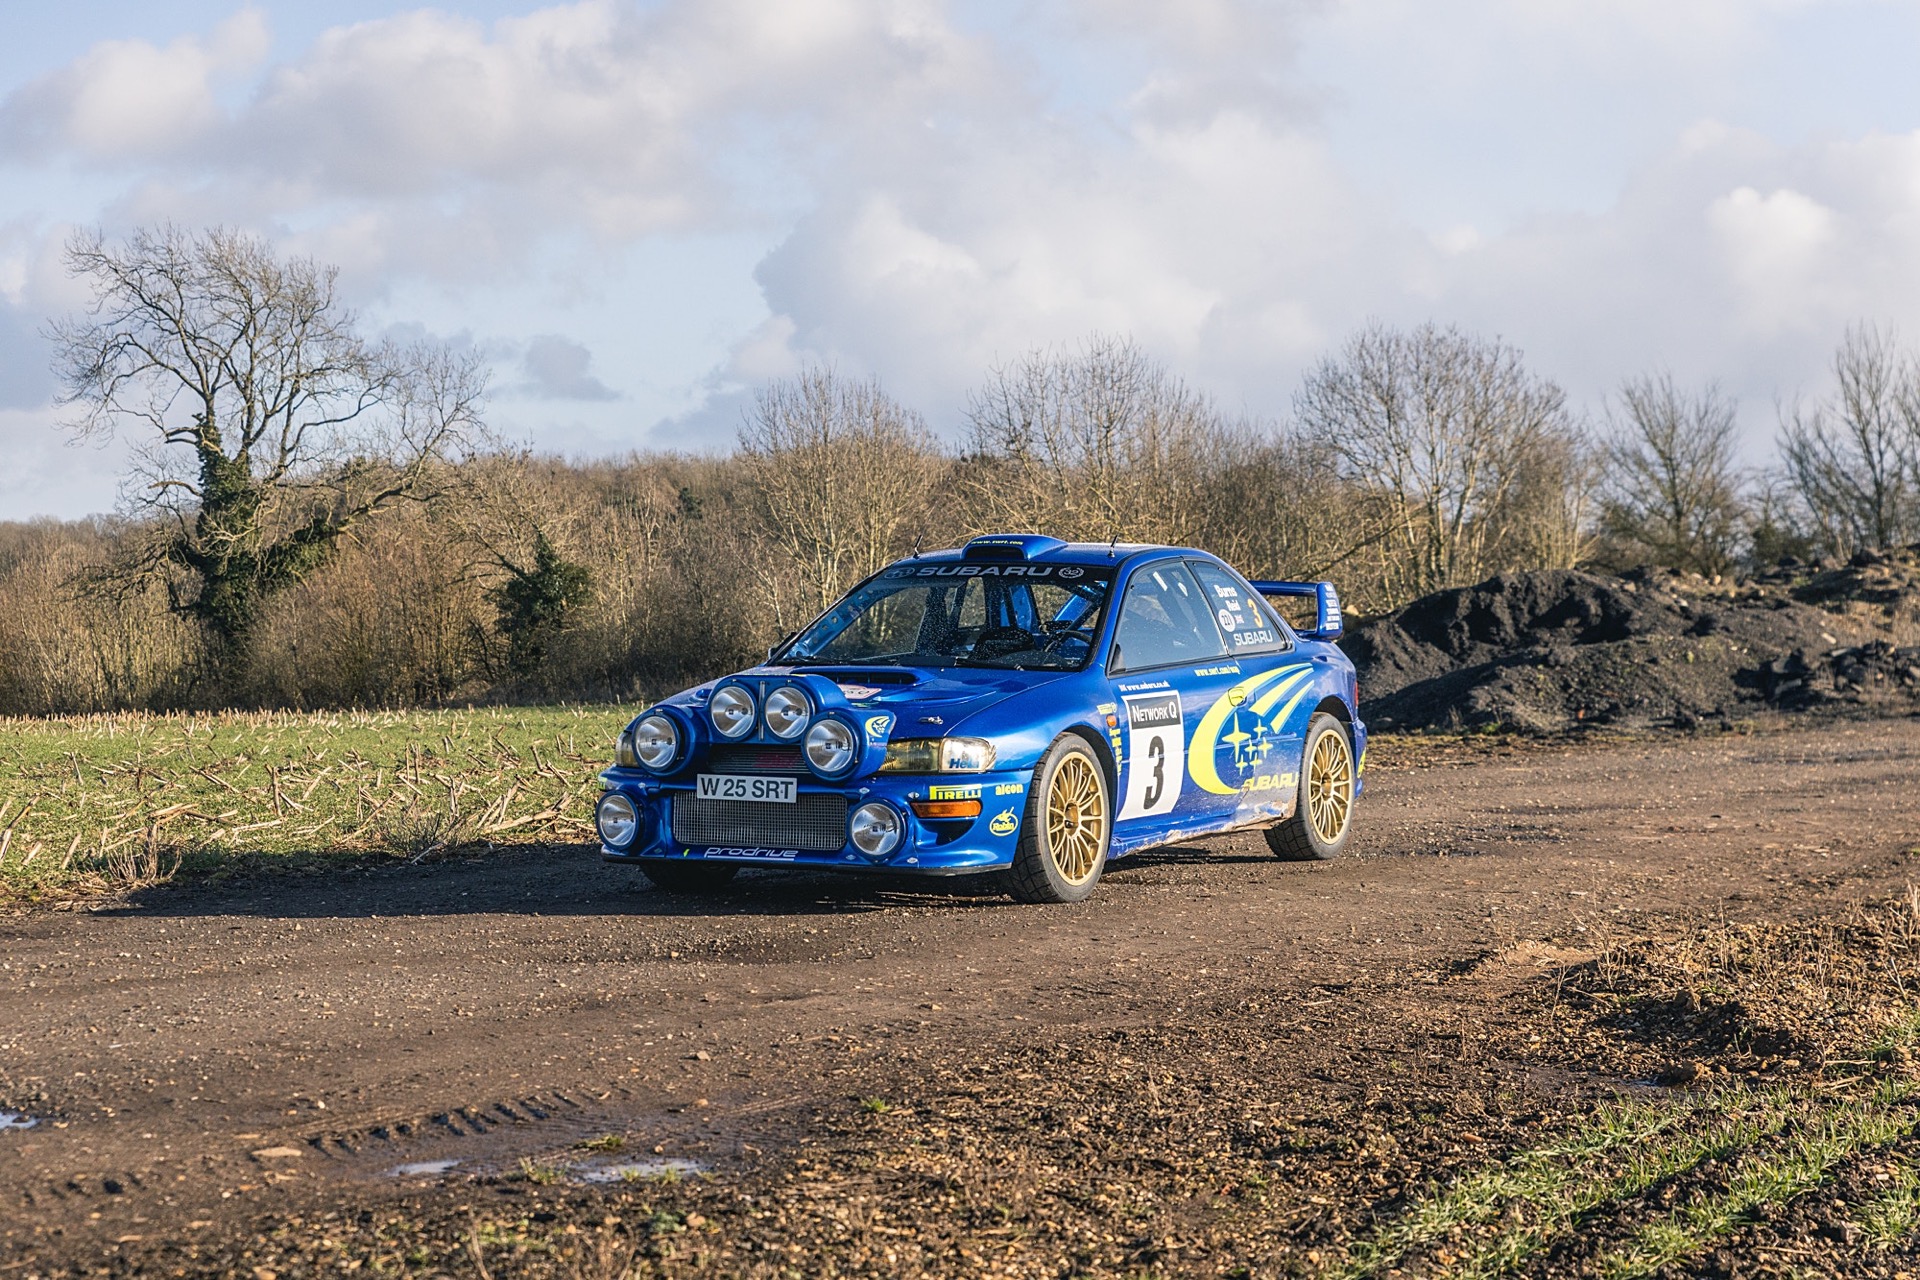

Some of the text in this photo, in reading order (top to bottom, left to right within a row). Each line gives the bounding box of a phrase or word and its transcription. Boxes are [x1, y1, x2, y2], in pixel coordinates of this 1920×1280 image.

[916, 566, 1053, 576] SUBARU
[1247, 598, 1263, 628] 3
[1233, 630, 1273, 645] SUBARU
[1168, 701, 1178, 719] Q
[1143, 735, 1165, 810] 3
[700, 777, 794, 800] W 25 SRT
[995, 783, 1024, 796] alcon
[1241, 771, 1299, 792] SUBARU
[929, 784, 982, 800] PIRELLI
[703, 847, 799, 859] prodrive
